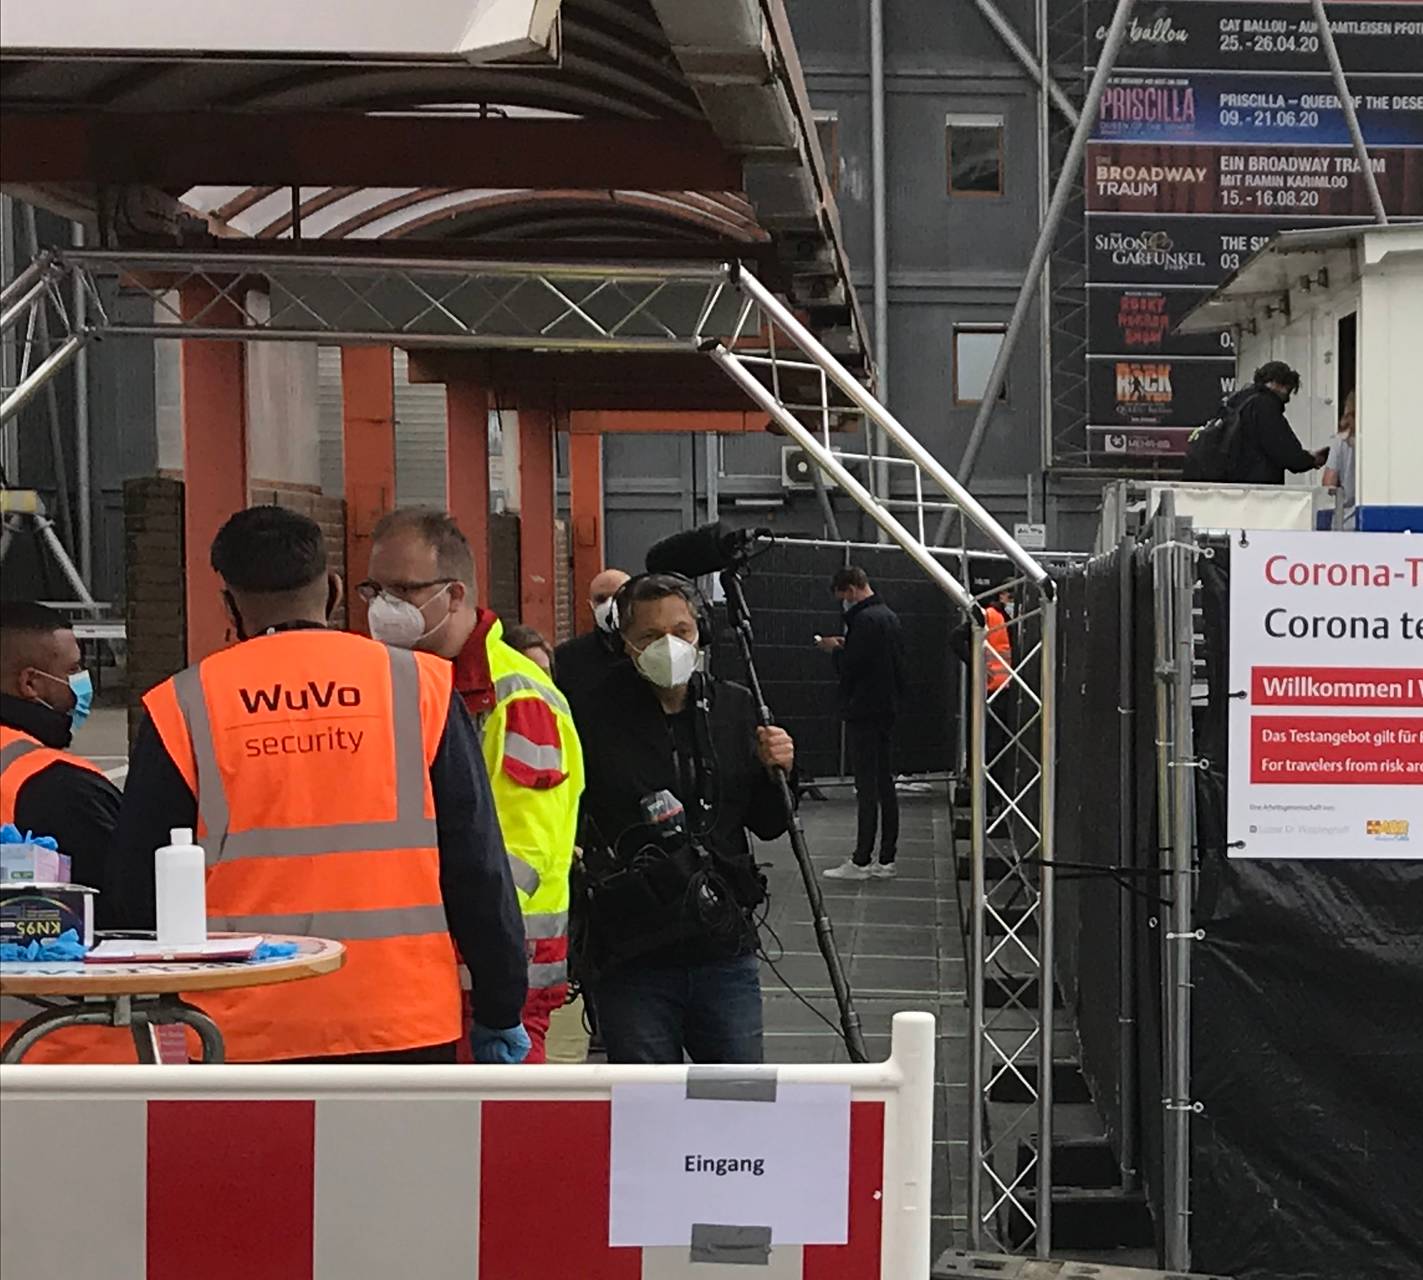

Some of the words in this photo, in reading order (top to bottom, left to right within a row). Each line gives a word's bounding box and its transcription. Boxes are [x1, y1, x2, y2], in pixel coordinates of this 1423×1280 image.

[1219, 19, 1241, 32] CAT
[1243, 19, 1287, 33] BALLOU
[1219, 93, 1285, 108] PRISCILLA
[1366, 96, 1389, 109] THE
[1220, 156, 1244, 171] EIN
[1248, 156, 1330, 172] BROADWAY
[1096, 166, 1207, 182] BROADWAY
[1220, 174, 1241, 186] MIT
[1244, 175, 1284, 187] RAMIN
[1286, 175, 1348, 188] KARIMLOO
[1097, 182, 1158, 197] TRAUM
[1095, 234, 1148, 250] SIMON
[1220, 236, 1247, 251] THE
[1112, 250, 1206, 266] GARFUNKEL
[1264, 608, 1390, 640] Corona
[1262, 677, 1402, 698] Willkommen
[239, 681, 361, 714] WuVo
[245, 726, 364, 758] security
[1262, 730, 1287, 744] Das
[1289, 730, 1371, 746] Testangebot
[1373, 731, 1396, 747] gilt
[1398, 730, 1418, 744] für
[1262, 759, 1284, 771] For
[1285, 758, 1344, 772] travelers
[1345, 759, 1379, 772] from
[1380, 759, 1405, 773] risk
[16, 920, 61, 935] KN95
[684, 1155, 765, 1177] Eingang
